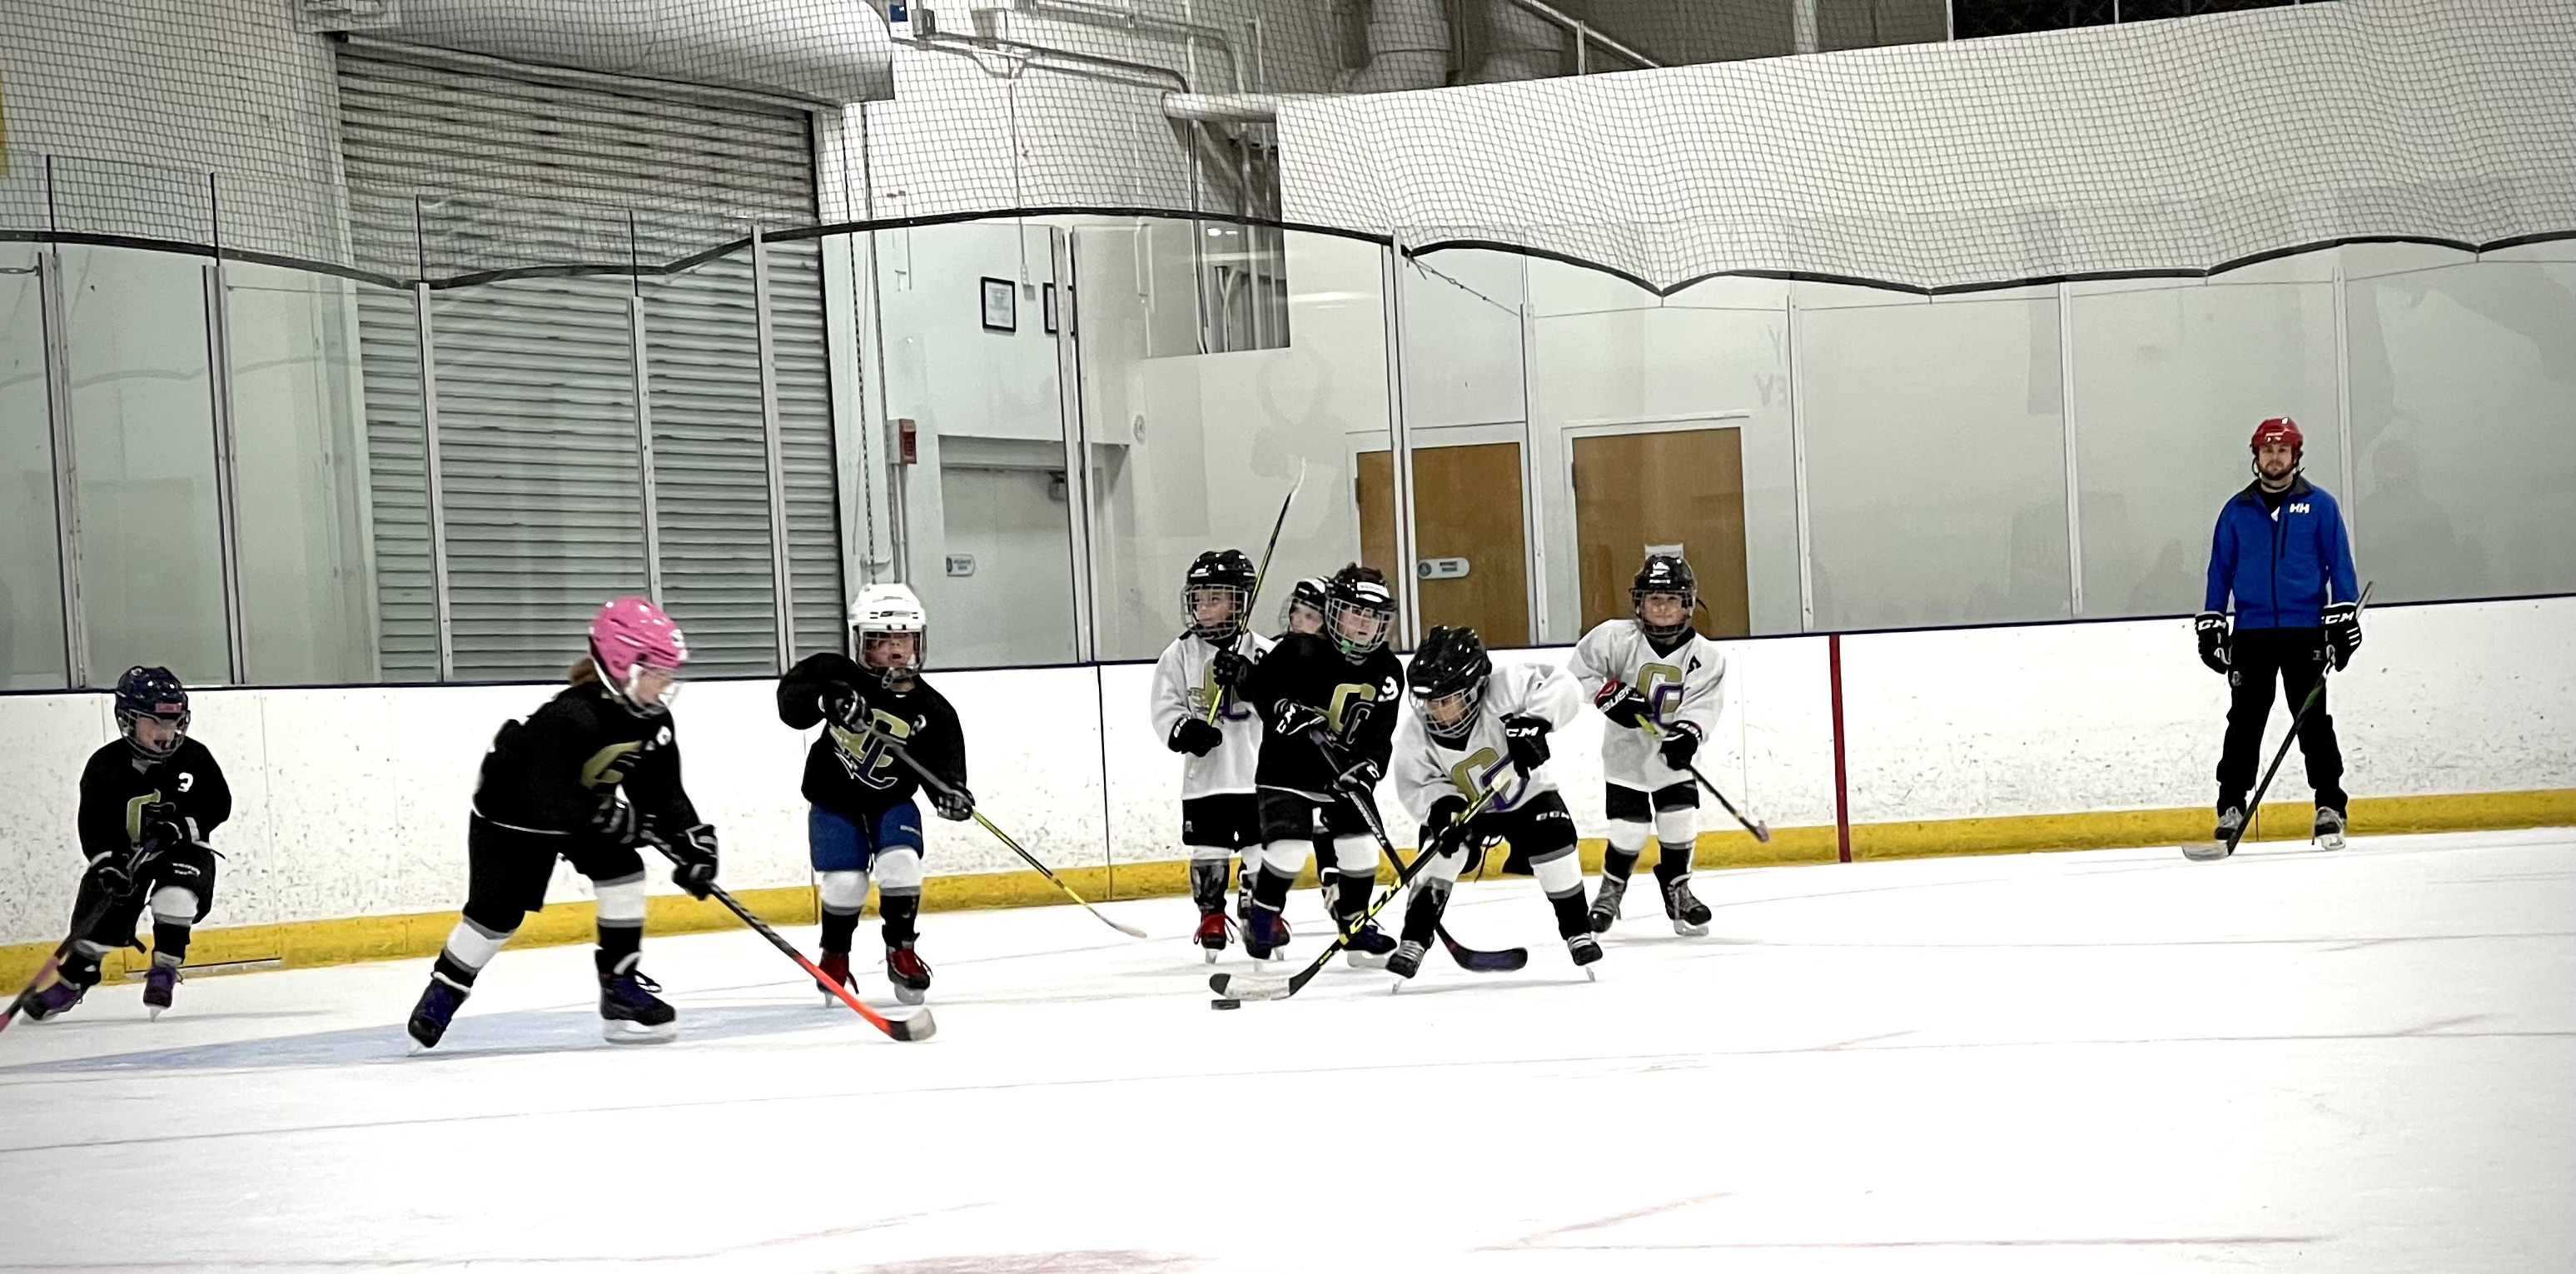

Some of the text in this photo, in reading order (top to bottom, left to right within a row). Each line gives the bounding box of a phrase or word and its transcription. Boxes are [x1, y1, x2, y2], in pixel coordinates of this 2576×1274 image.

[2290, 503, 2310, 514] HH
[2197, 619, 2227, 631] CM
[1599, 685, 1633, 713] AUER
[1504, 726, 1539, 738] CM
[177, 771, 194, 793] 3
[1349, 876, 1402, 934] CCM
